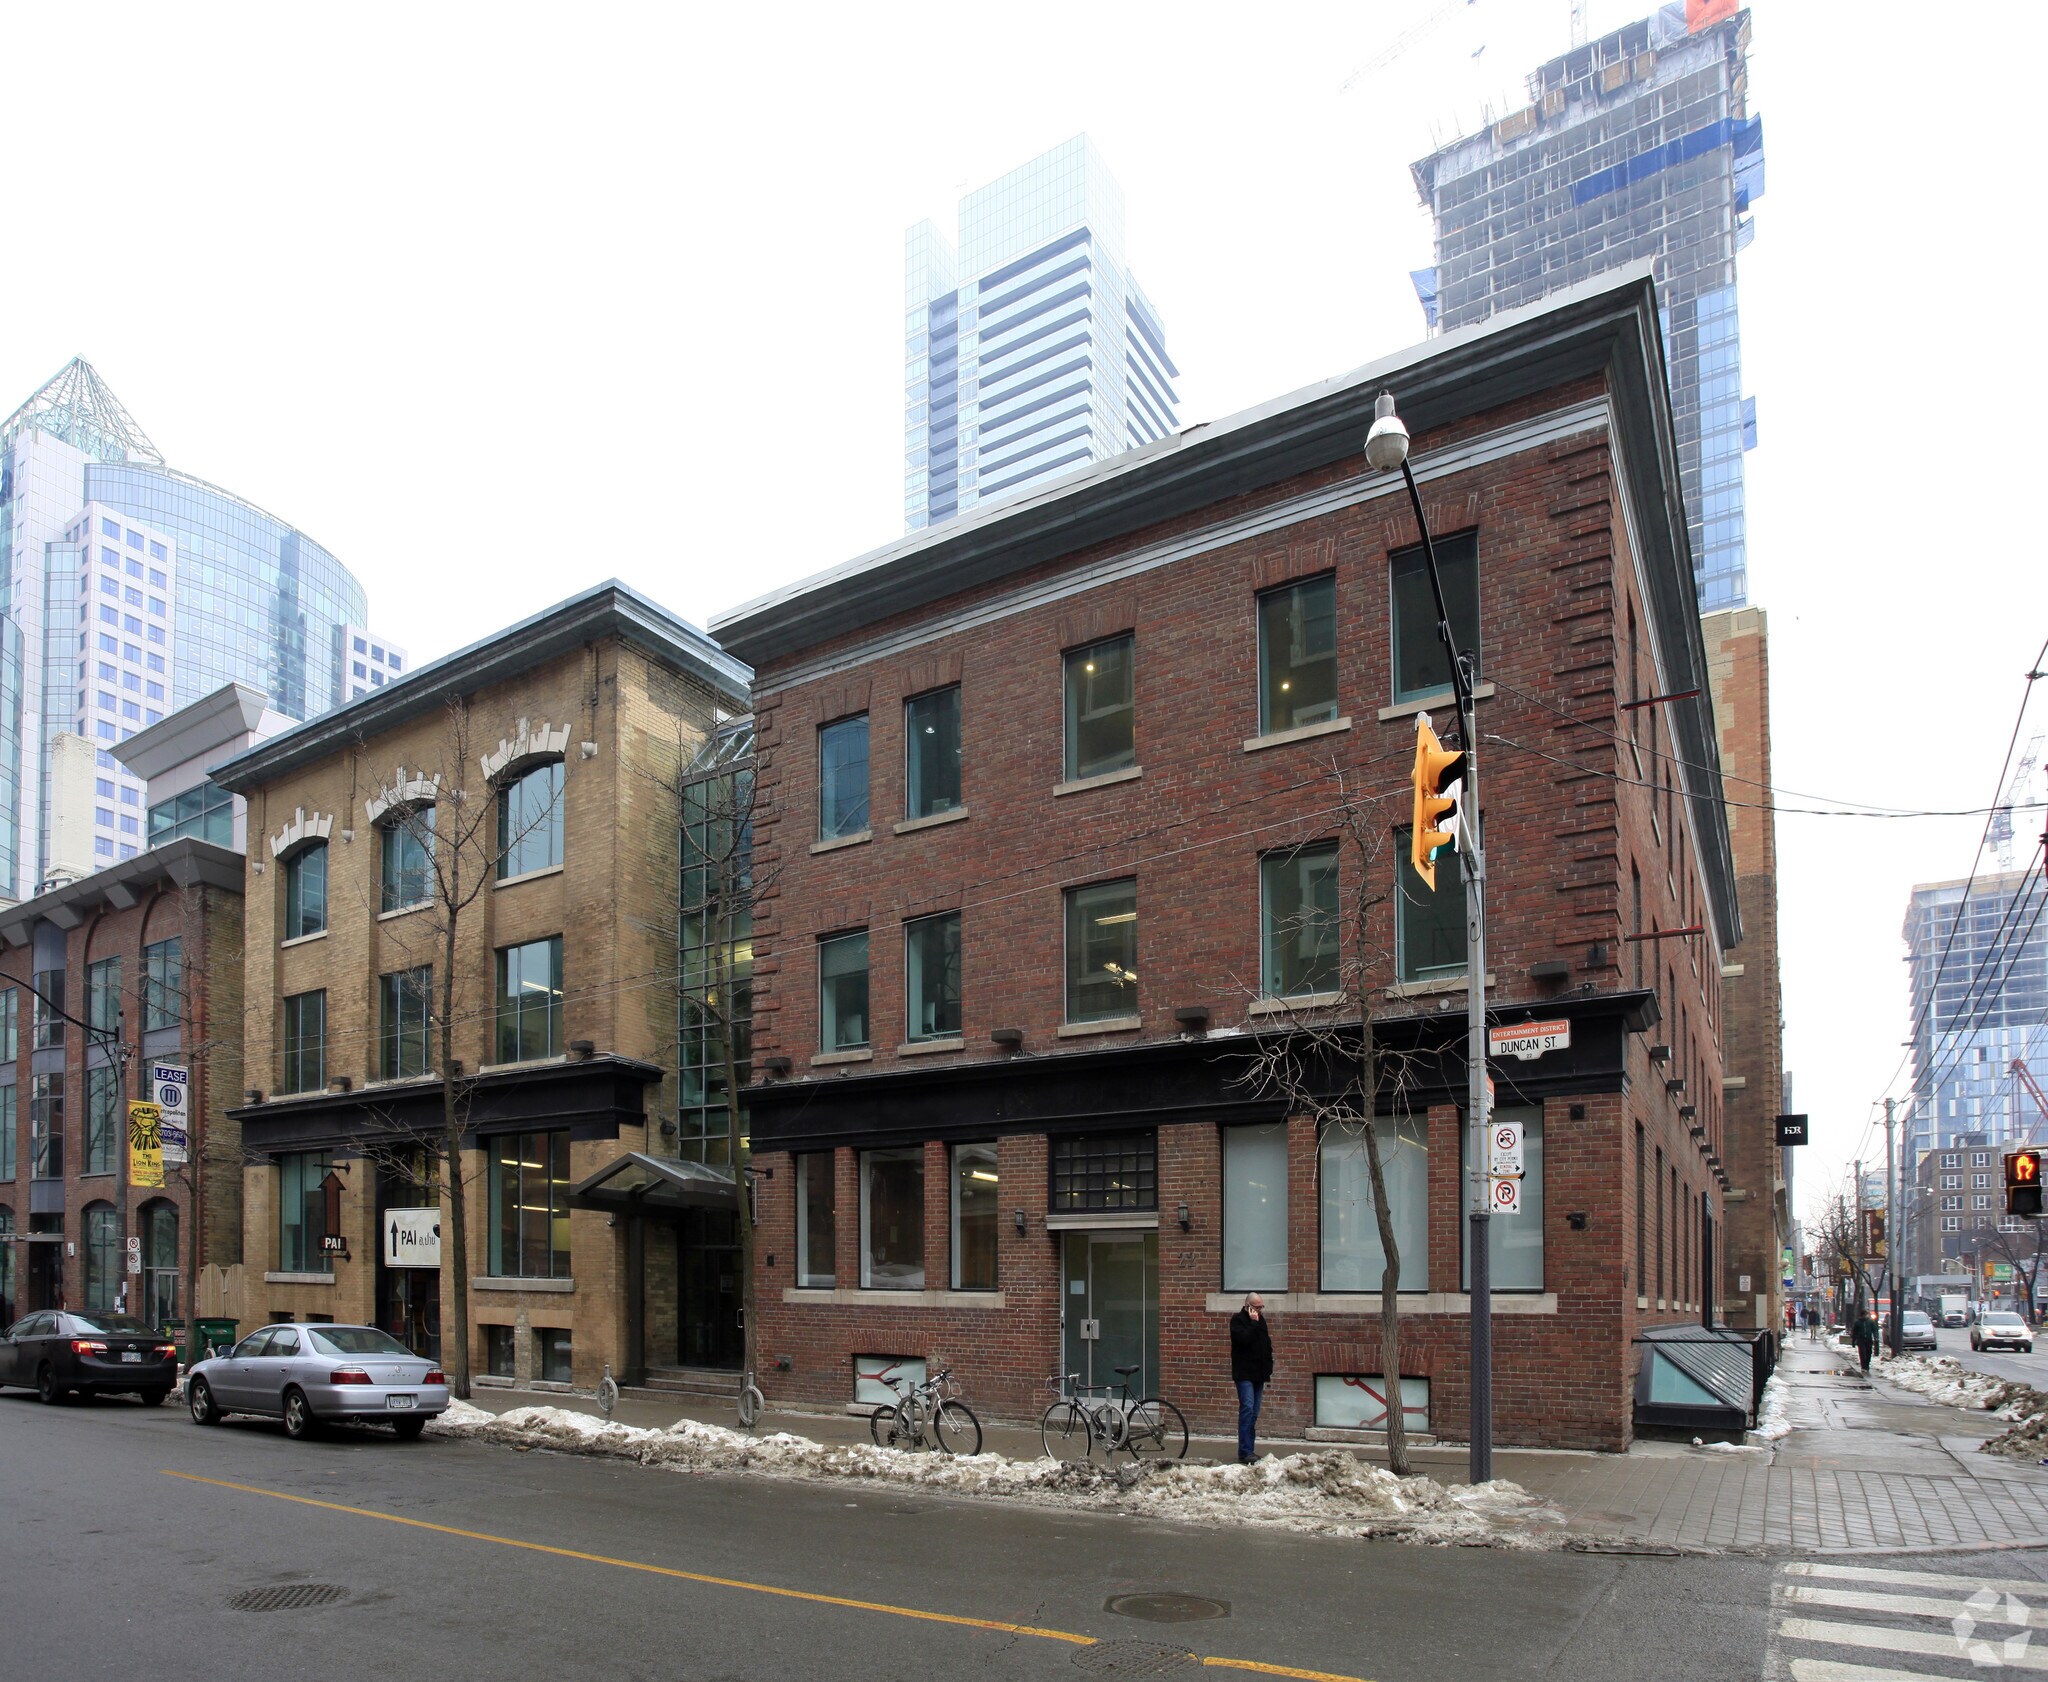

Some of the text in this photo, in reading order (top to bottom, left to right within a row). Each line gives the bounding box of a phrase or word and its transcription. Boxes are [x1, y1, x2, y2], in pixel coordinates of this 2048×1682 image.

[1492, 1023, 1566, 1039] ENTERTAINMENT DISTRICT
[1501, 1036, 1558, 1054] DUNCAN ST.
[155, 1068, 186, 1083] LEASE
[1784, 1126, 1801, 1135] HDR
[132, 1159, 161, 1168] LION KING
[324, 1237, 341, 1250] PAI
[401, 1229, 417, 1246] PAI
[1177, 1252, 1197, 1267] 22
